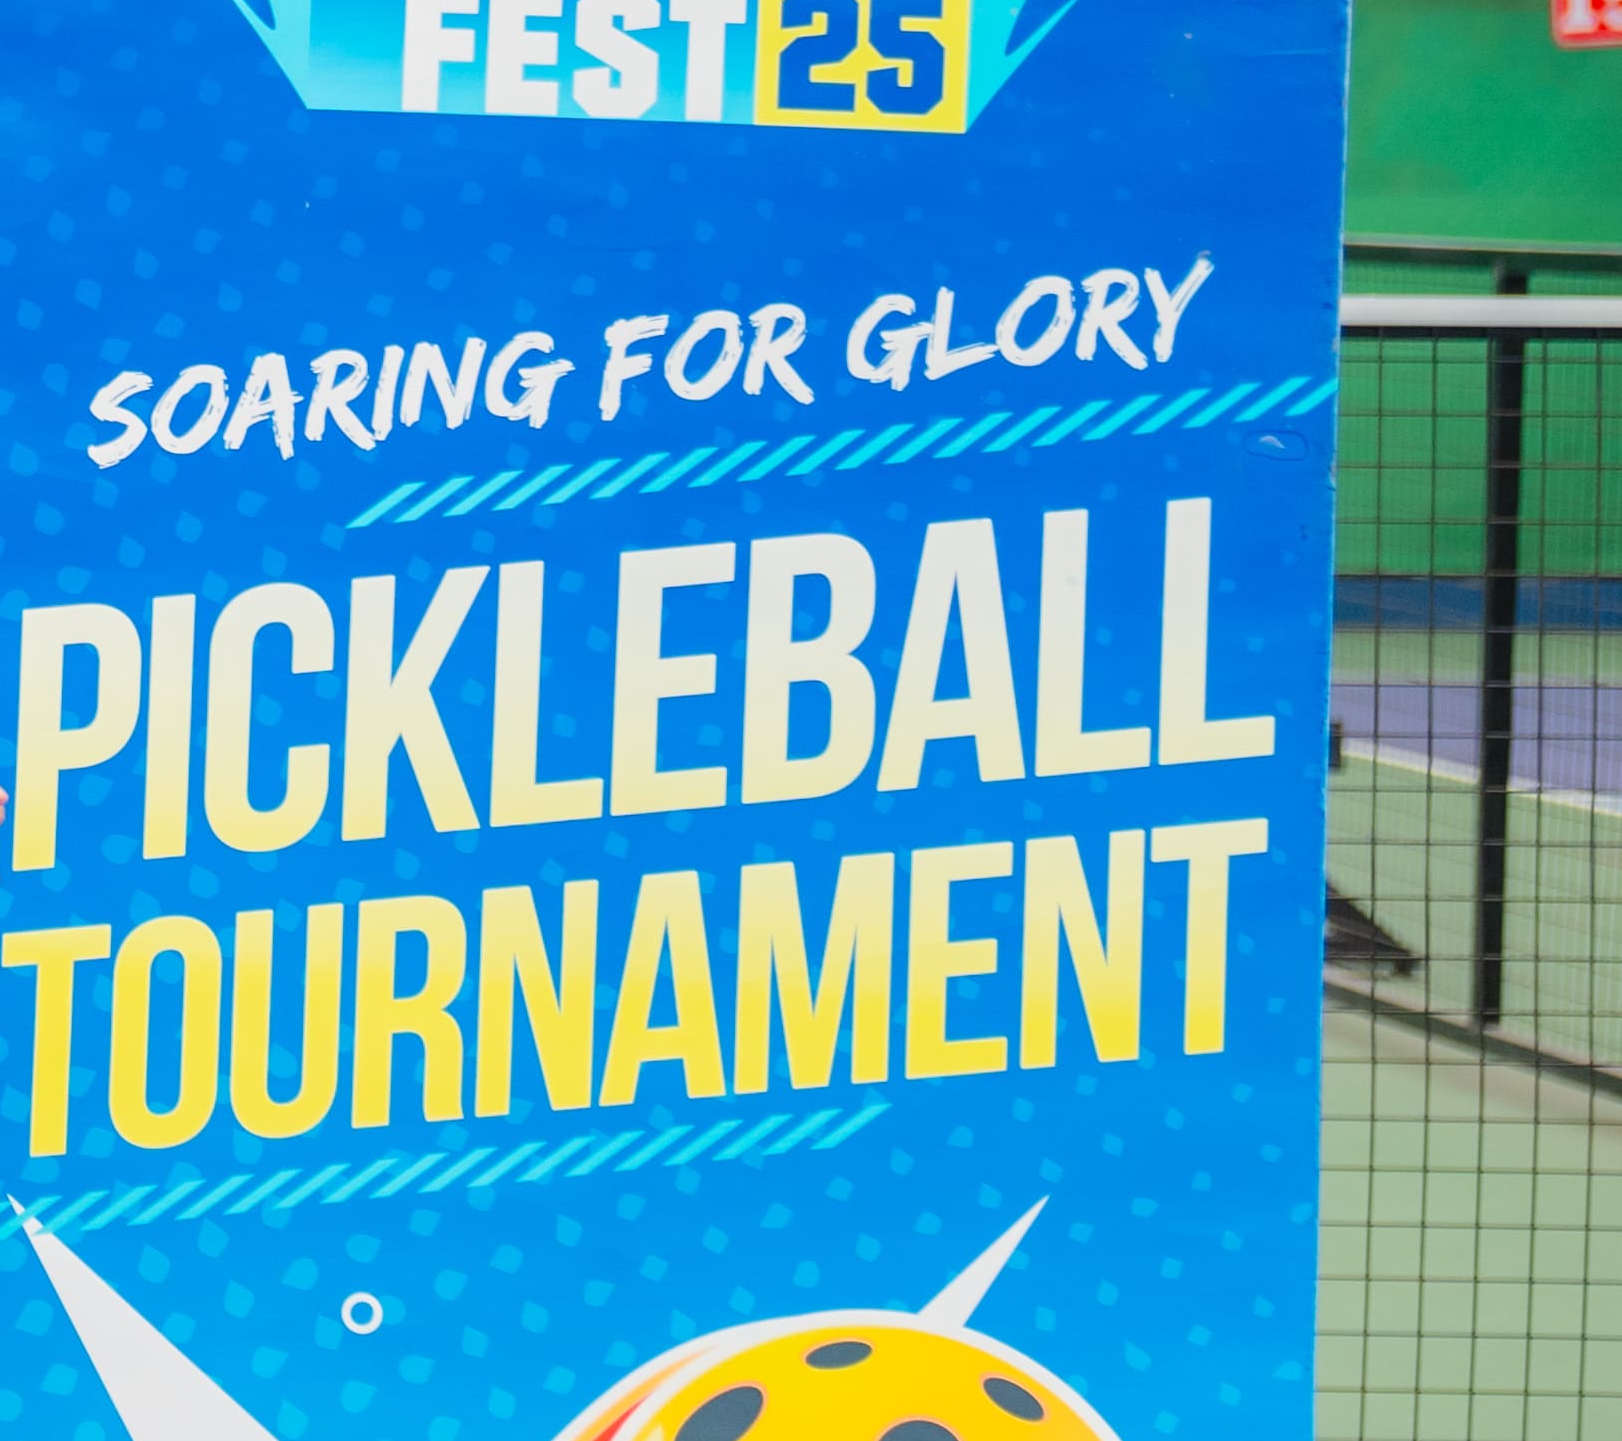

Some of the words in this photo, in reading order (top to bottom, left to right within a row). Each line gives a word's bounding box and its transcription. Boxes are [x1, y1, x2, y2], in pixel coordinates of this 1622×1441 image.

[87, 330, 575, 469] SOARING
[599, 296, 816, 419] FOR
[845, 250, 1215, 392] GLORY
[10, 495, 1276, 873] PICKLEBALL
[0, 817, 1269, 1158] TOURNAMENT
